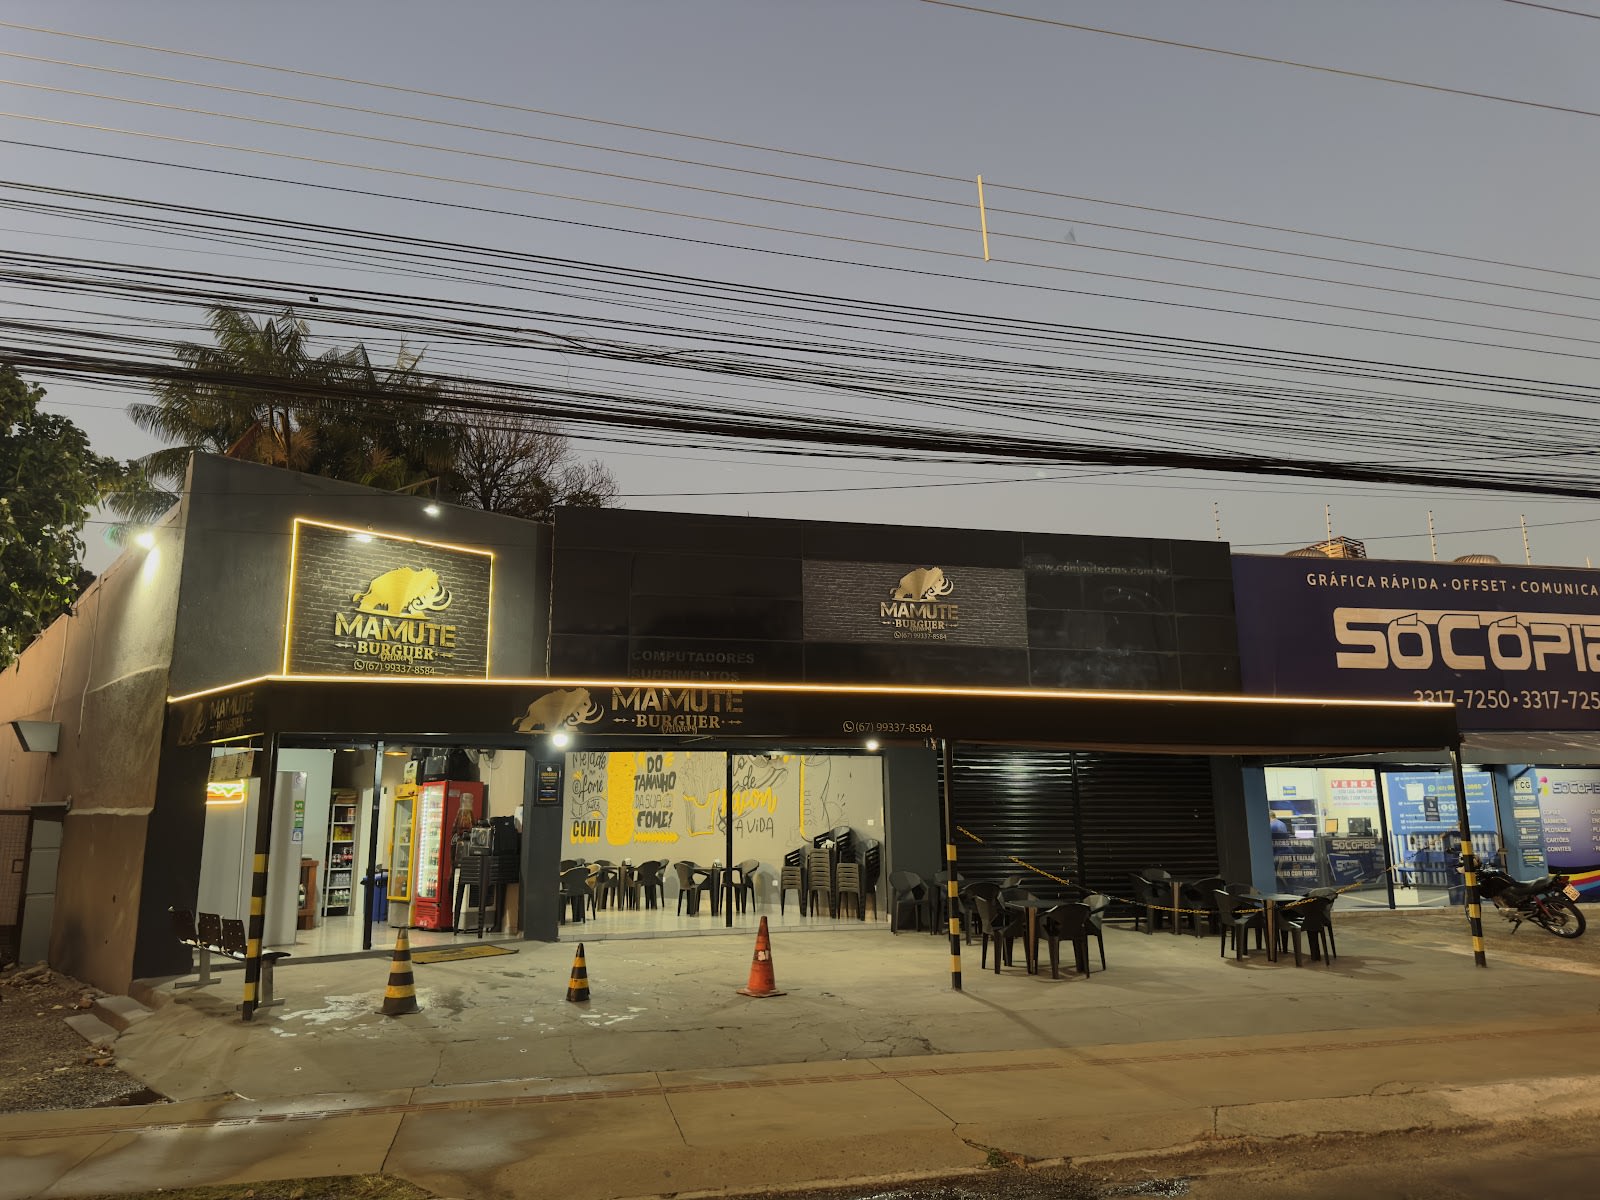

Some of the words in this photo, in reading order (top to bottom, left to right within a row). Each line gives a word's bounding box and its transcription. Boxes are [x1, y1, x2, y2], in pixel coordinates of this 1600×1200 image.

[1307, 571, 1376, 588] GRÁFICA
[1381, 573, 1439, 590] RÁPIDA
[1452, 578, 1507, 592] OFFSET
[1520, 581, 1599, 596] COMUNICA
[881, 601, 959, 620] MAMUTE
[335, 612, 456, 648] MAMUTE
[895, 619, 945, 630] BURGUER
[357, 641, 434, 660] BURGUER
[632, 651, 754, 664] COMPUTADORES
[365, 662, 383, 672] (67)
[385, 663, 435, 675] 99337-8584
[611, 686, 744, 713] MAMUTE
[1413, 690, 1510, 709] 3317-7250
[636, 714, 721, 729] BURGUER
[855, 722, 874, 733] (67)
[876, 722, 933, 733] 99337-8584
[647, 754, 663, 774] DO
